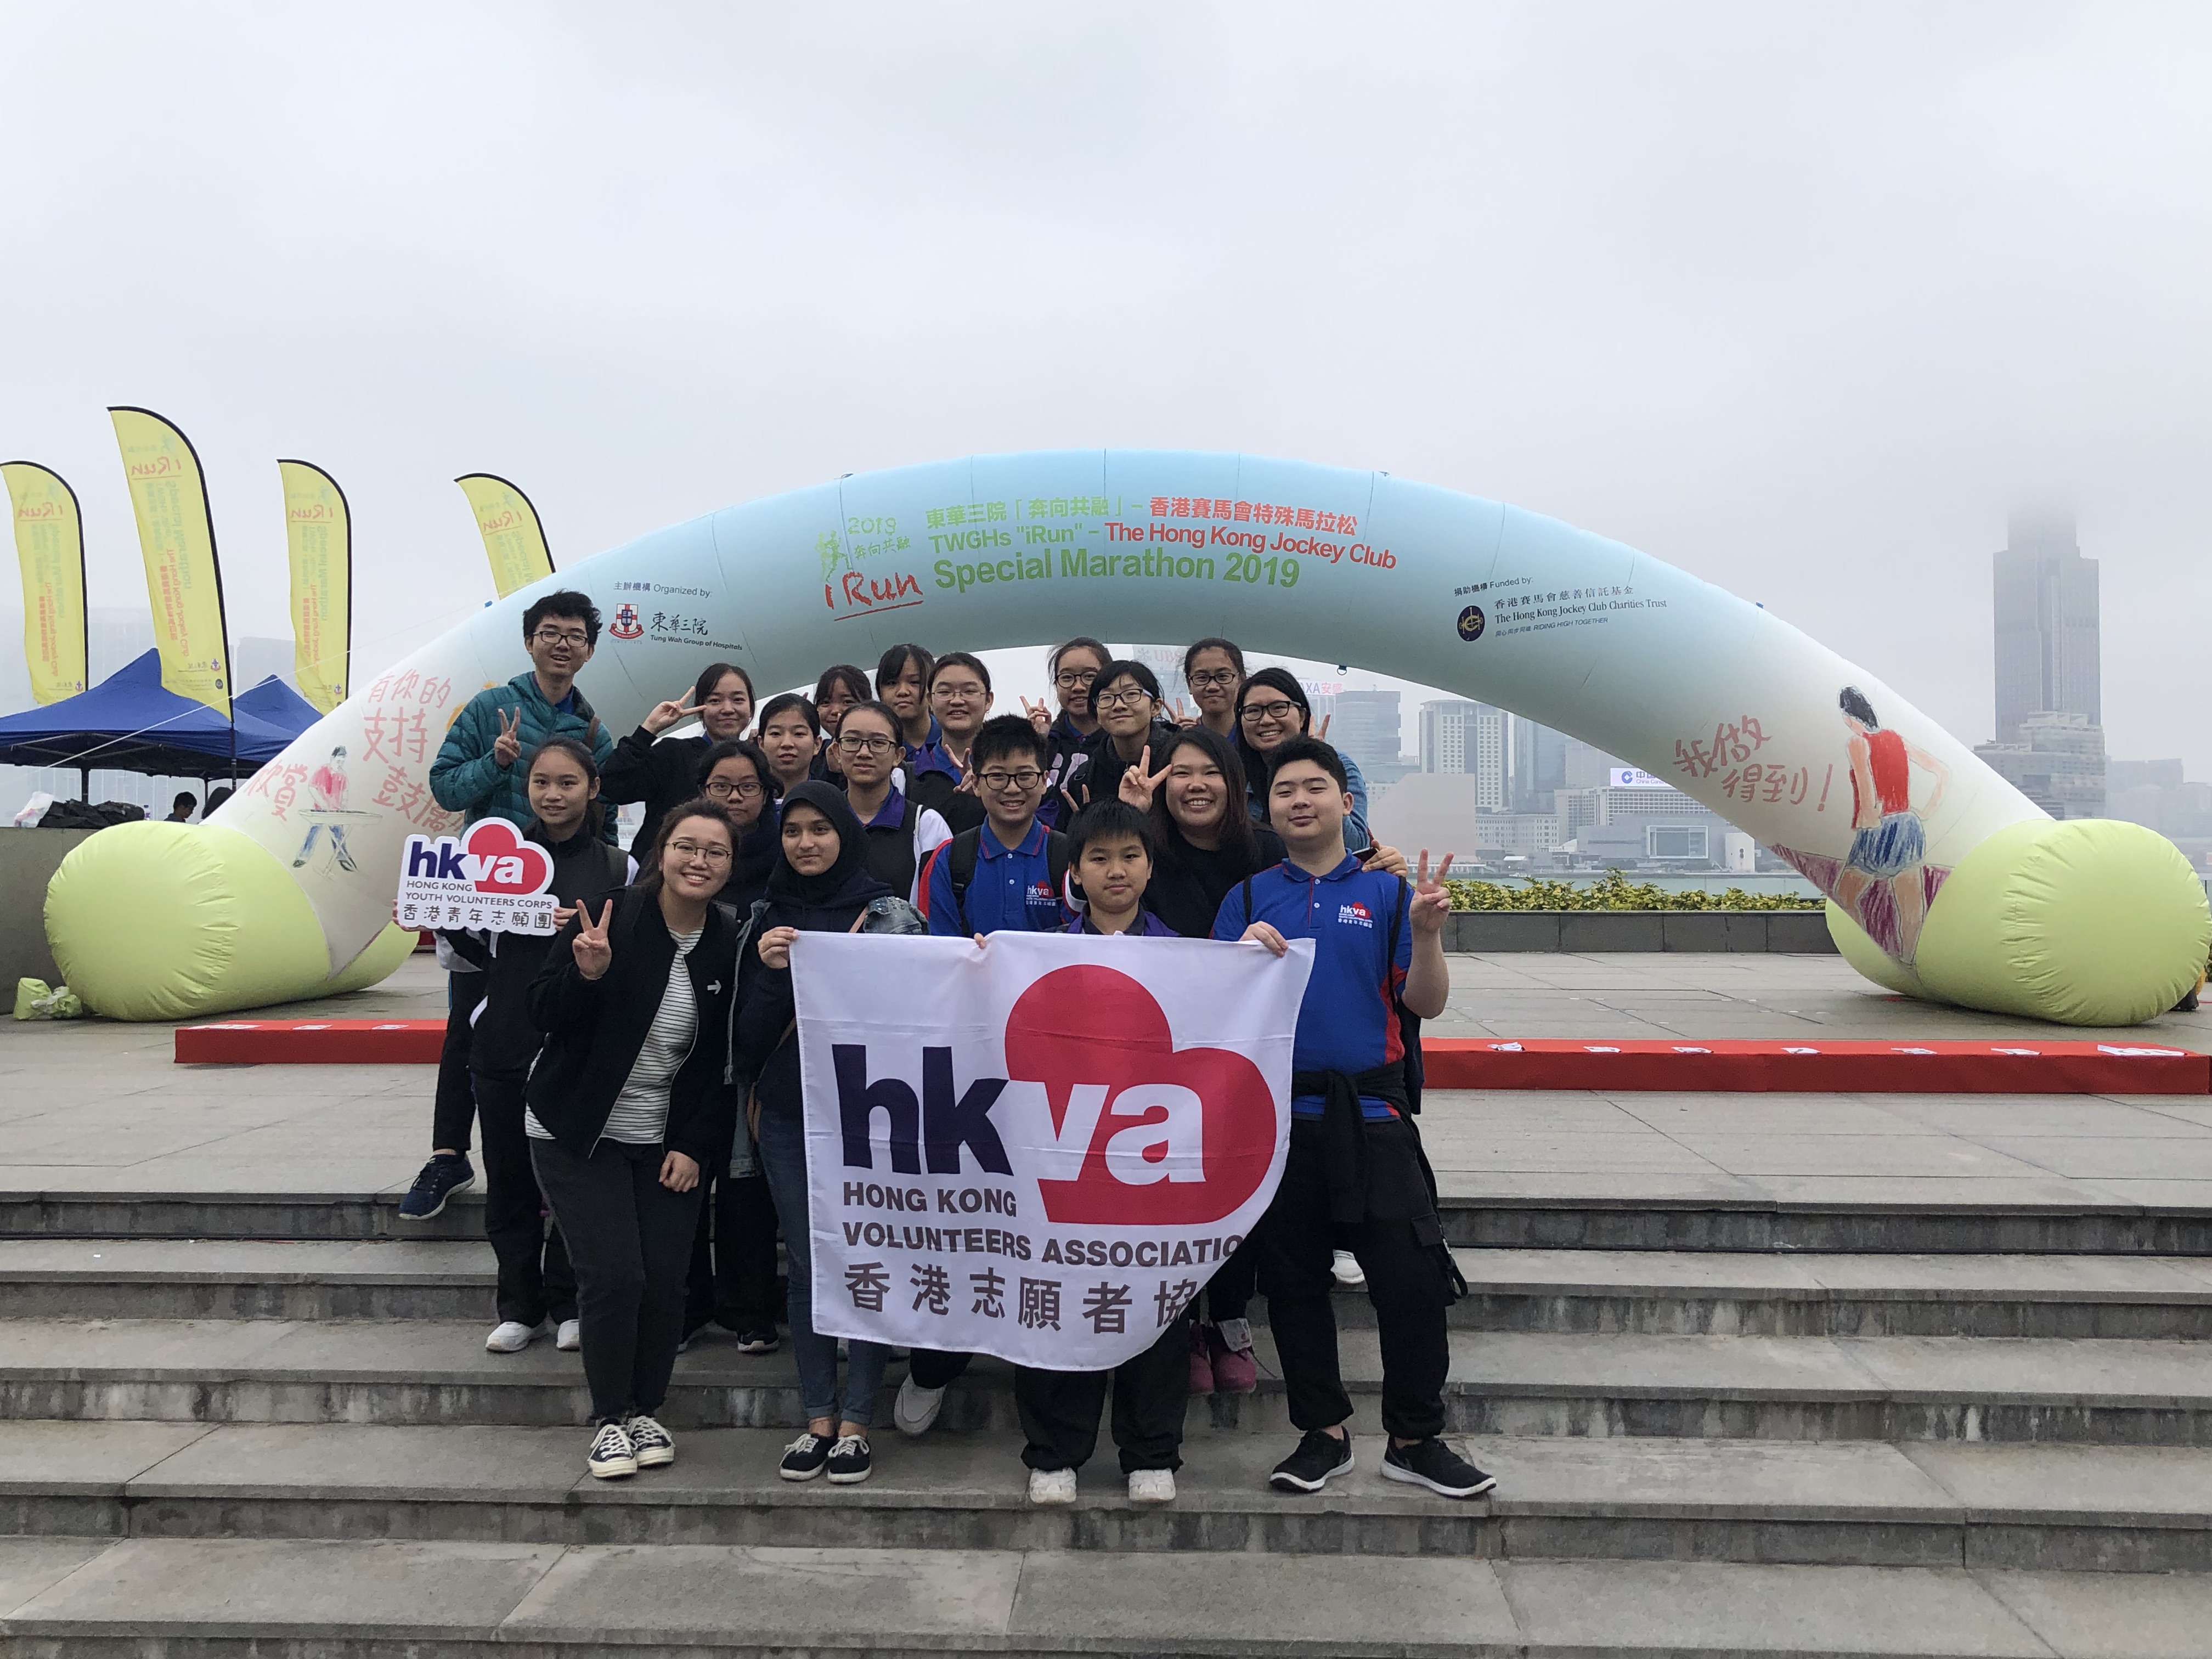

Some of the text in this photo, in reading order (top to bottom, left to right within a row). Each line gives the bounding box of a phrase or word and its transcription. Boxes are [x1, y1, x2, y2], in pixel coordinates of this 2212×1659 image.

[848, 517, 896, 535] 2019
[1149, 496, 1358, 537] 香港賽馬會特殊馬拉松
[928, 528, 1012, 554] TWGHs
[1016, 522, 1083, 544] "iRun"
[1104, 522, 1144, 541] The
[1149, 523, 1205, 549] Hong
[1210, 526, 1266, 553] Kong
[1270, 531, 1346, 564] Jockey
[1350, 543, 1397, 569] Club
[934, 547, 1300, 593] Special Marathon 2019
[654, 584, 697, 595] Organized
[1489, 578, 1520, 589] Funded
[1494, 585, 1634, 610] 香港賽馬會慈善信託基金
[650, 611, 708, 635] 東華三院
[1494, 598, 1667, 624] The Hong Kong Jockey Club Charities Trust
[1533, 622, 1556, 631] RIDING
[1557, 620, 1573, 629] HIGH
[1575, 617, 1609, 627] TOGETHER
[650, 634, 667, 642] Tung
[684, 637, 704, 646] Group
[713, 641, 743, 651] Hospitals
[368, 668, 452, 709] 有你的
[363, 707, 428, 764] 支持
[1673, 715, 1772, 777] 我做
[408, 841, 524, 884] hkva
[407, 880, 472, 891] HONG KONG
[1027, 885, 1049, 896] hkva
[406, 892, 552, 909] YOUTH VOLUNTEERS CORPS
[1340, 905, 1366, 916] hkva
[404, 904, 552, 929] 香港青年志願團
[832, 1043, 1205, 1186] hkva
[843, 1181, 1017, 1217] HONG KONG
[843, 1221, 1031, 1261] VOLUNTEERS
